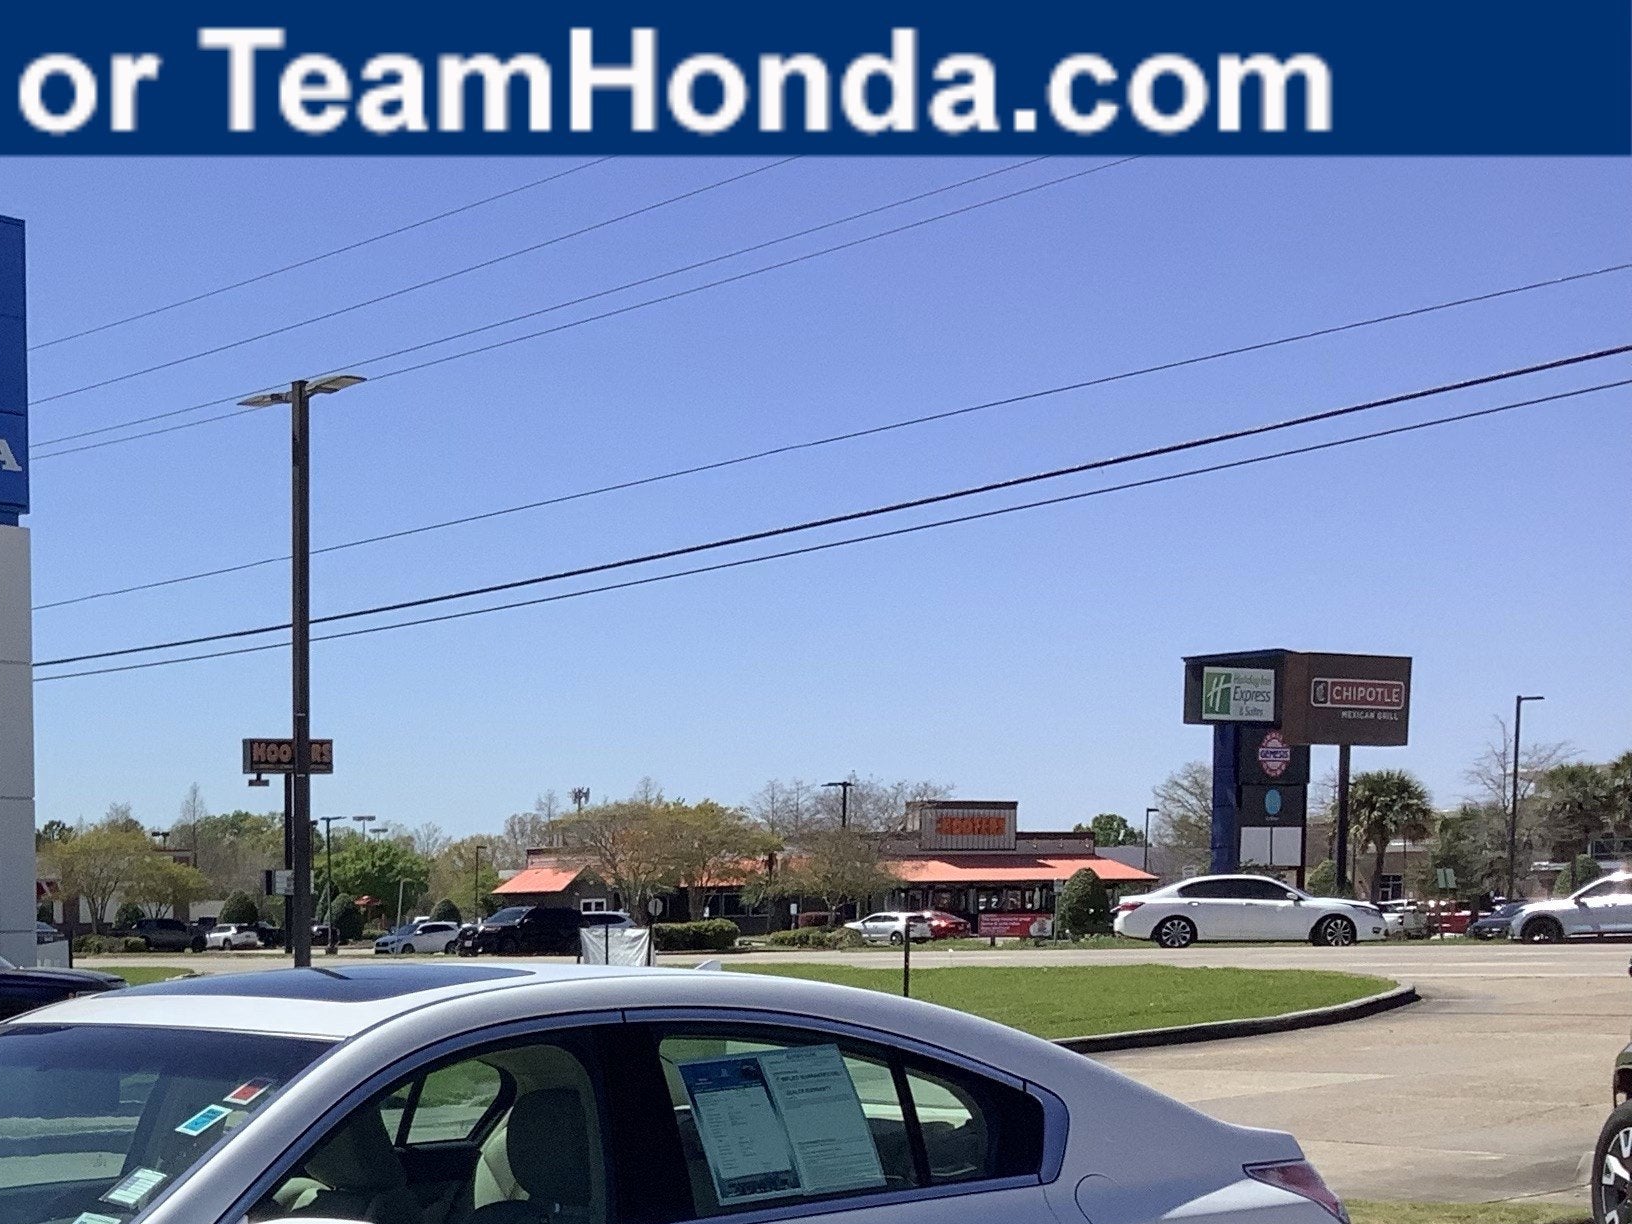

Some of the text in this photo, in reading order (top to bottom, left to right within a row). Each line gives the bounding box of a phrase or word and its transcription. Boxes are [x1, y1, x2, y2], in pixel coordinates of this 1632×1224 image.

[1233, 685, 1272, 704] Express
[1332, 685, 1401, 702] CHIPOTLE
[252, 742, 331, 763] HOORS
